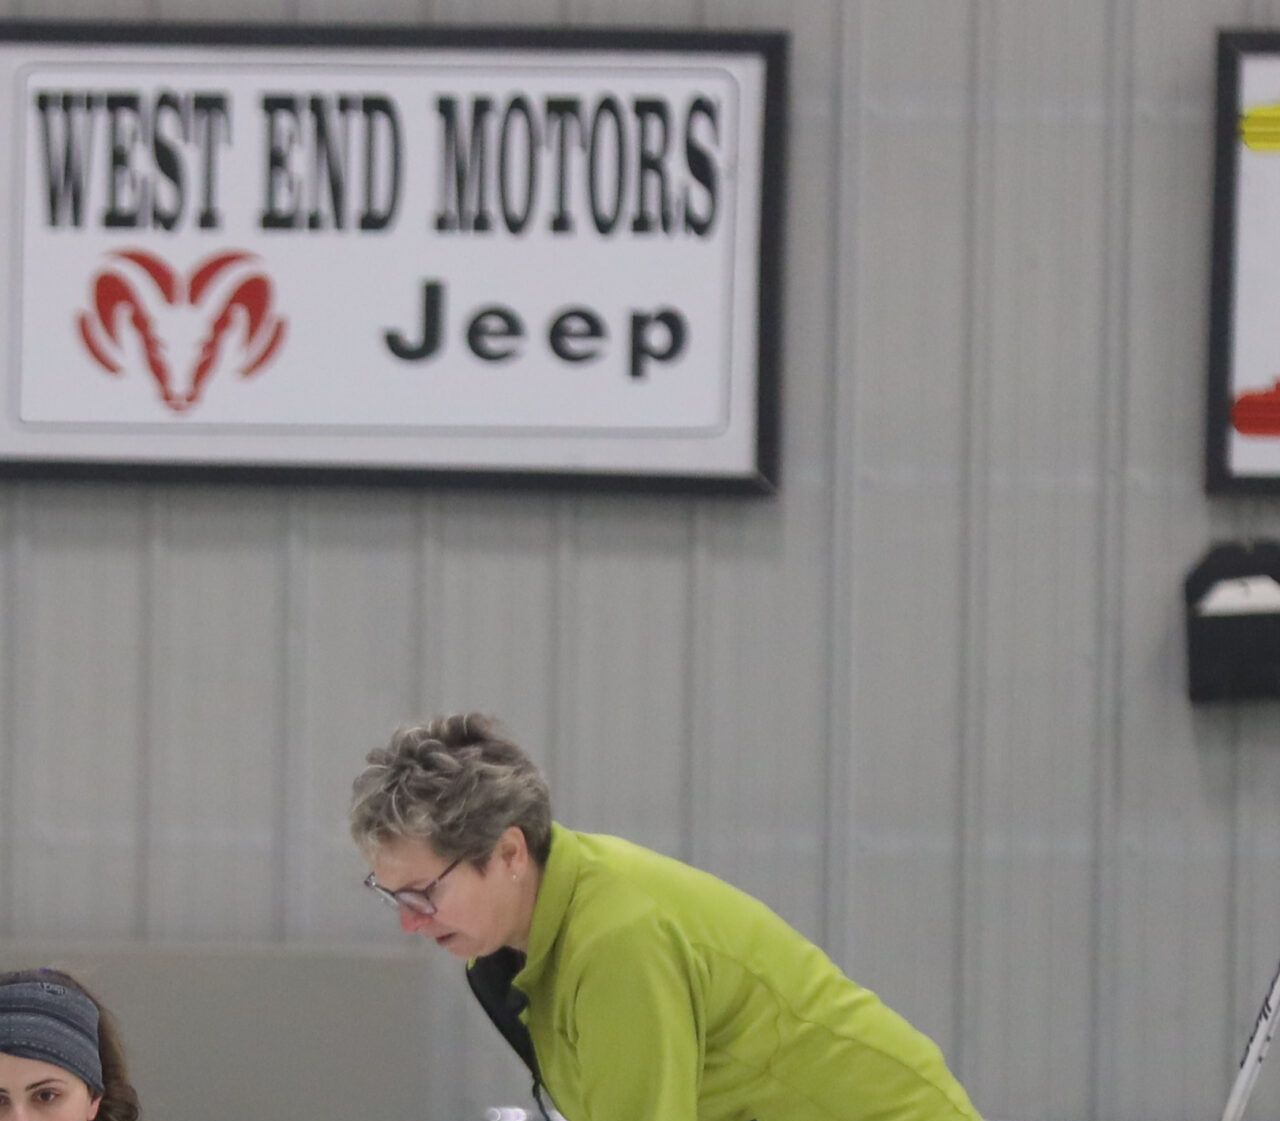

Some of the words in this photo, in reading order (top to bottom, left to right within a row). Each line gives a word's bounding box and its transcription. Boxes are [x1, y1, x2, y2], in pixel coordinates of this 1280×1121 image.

[35, 90, 231, 234] WEST
[258, 92, 405, 233] END
[432, 92, 721, 239] MOTORS
[383, 279, 690, 381] Jeep
